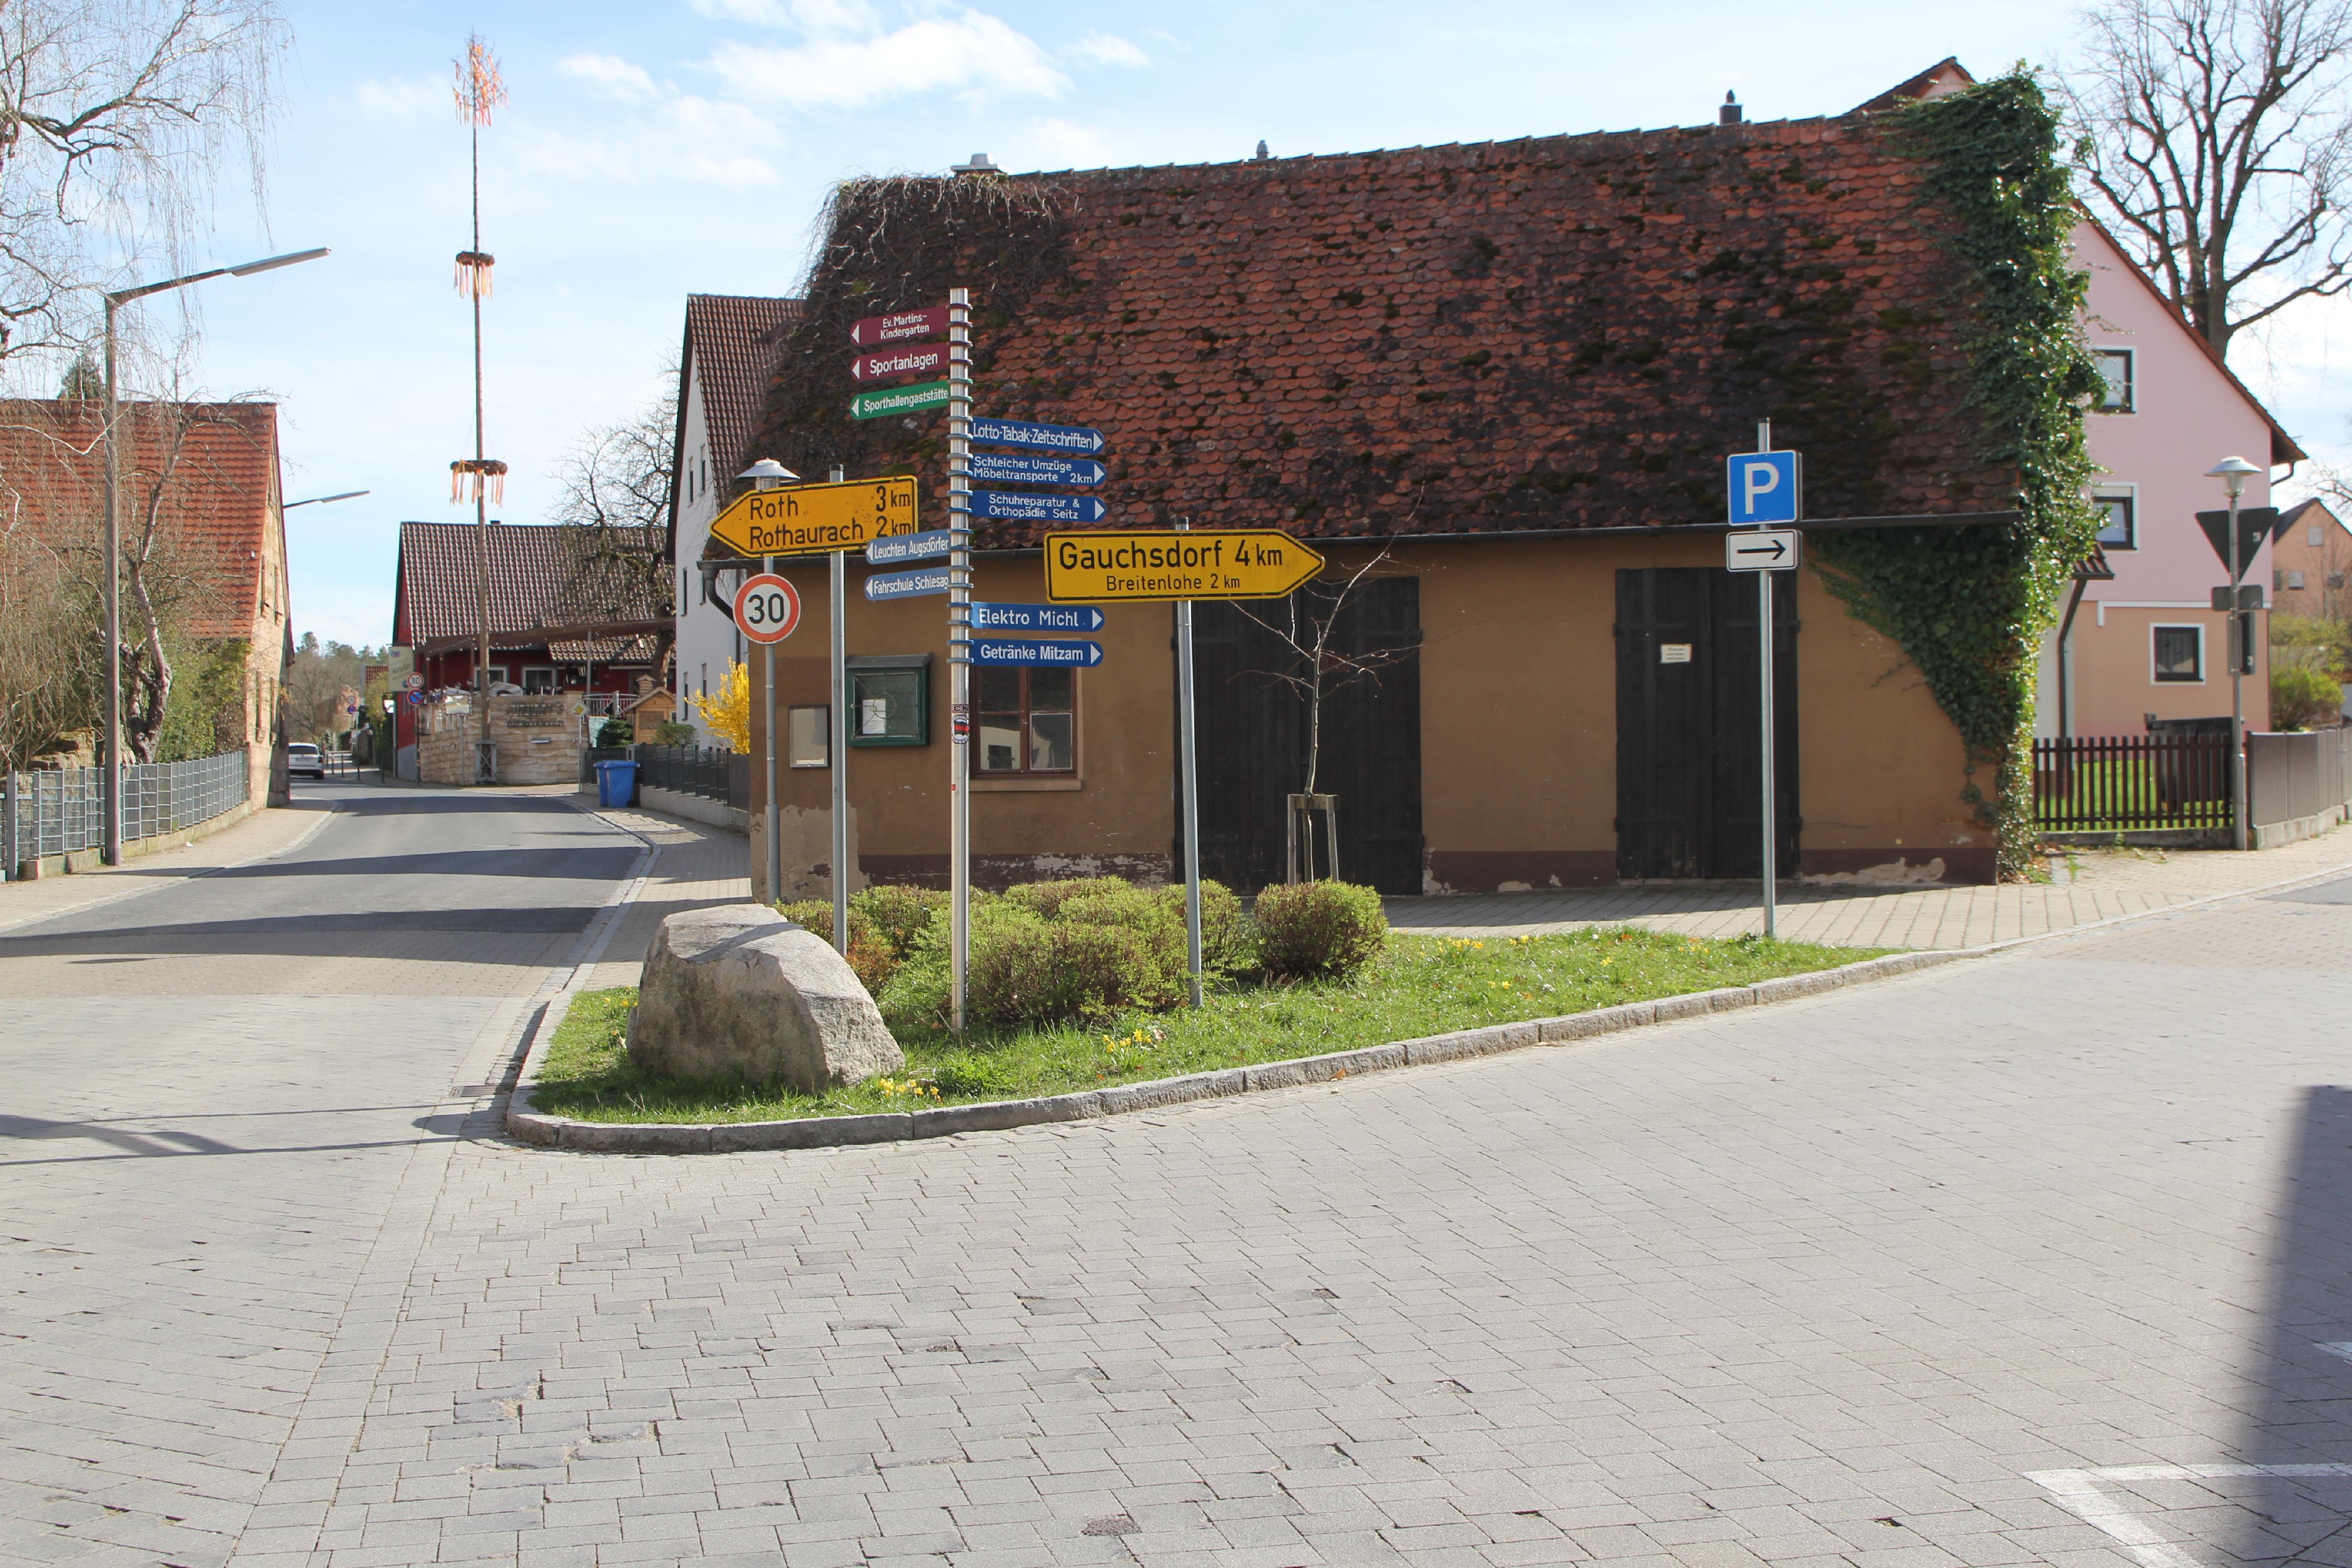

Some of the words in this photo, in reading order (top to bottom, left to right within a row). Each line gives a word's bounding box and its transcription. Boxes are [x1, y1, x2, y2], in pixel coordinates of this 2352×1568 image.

[880, 324, 929, 339] Kindergarten
[870, 353, 938, 376] Sportanlagen
[864, 388, 948, 414] Sporthallengaststätte
[973, 423, 1092, 449] Lotto-Tabak-Zeitschriften
[974, 456, 1028, 469] Schleicher
[1032, 460, 1072, 472] Umzüge
[974, 467, 1058, 482] Möbeltransporte
[1744, 462, 1779, 514] P
[750, 495, 799, 520] Roth
[876, 485, 886, 512] 3
[891, 490, 910, 508] km
[989, 494, 1066, 507] Schuhreparatur
[1073, 499, 1080, 508] &
[989, 506, 1046, 518] Orthopädie
[1053, 509, 1078, 519] Seitz
[750, 518, 863, 549] Rothaurach
[876, 515, 887, 538] 2
[892, 520, 911, 536] km
[874, 543, 906, 559] Leuchten
[908, 536, 949, 557] Augsdörfer
[1059, 540, 1222, 570] Gauchsdorf
[1235, 540, 1250, 567] 4
[1257, 543, 1282, 566] km
[874, 578, 914, 594] Fahrschule
[1107, 574, 1202, 591] Breitenlohe
[1210, 573, 1219, 589] 2
[1224, 575, 1240, 588] km
[748, 593, 784, 624] 30
[979, 608, 1030, 625] Elektro
[1039, 611, 1079, 626] Michl
[980, 645, 1036, 659] Getränke
[1040, 646, 1083, 660] Mitzam
